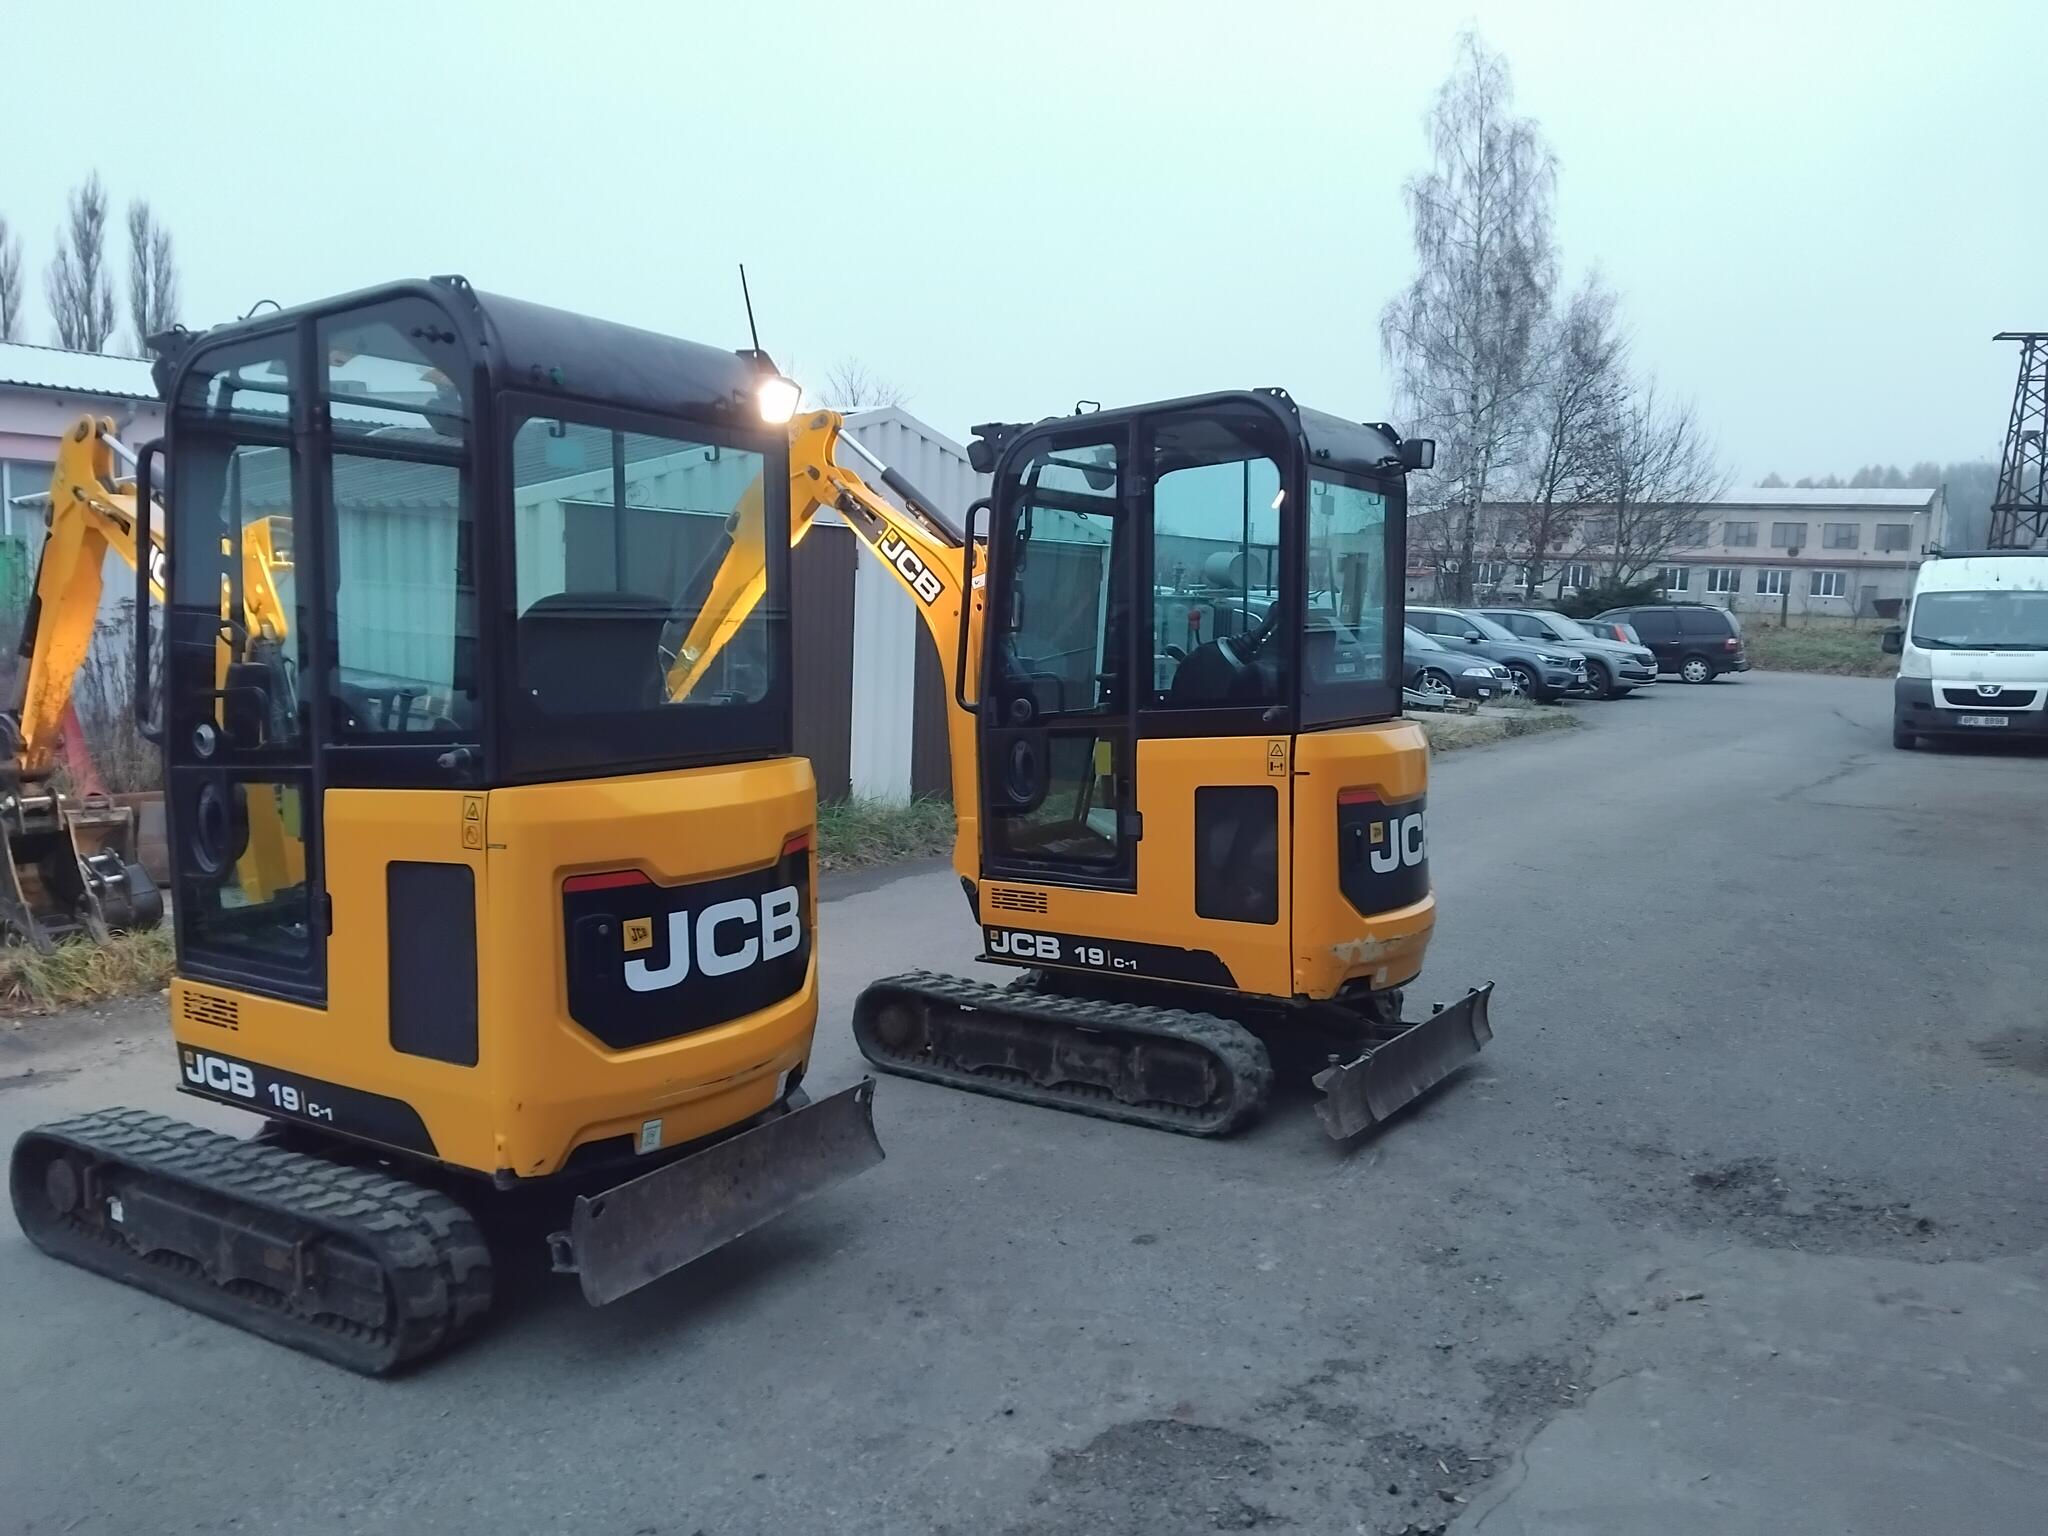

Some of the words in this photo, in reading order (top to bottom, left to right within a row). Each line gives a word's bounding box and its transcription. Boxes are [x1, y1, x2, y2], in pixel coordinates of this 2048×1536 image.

[880, 540, 941, 602] JCB
[624, 886, 800, 992] JCB
[631, 927, 648, 942] JCB
[990, 931, 1061, 960] JCB
[1074, 946, 1105, 965] 19
[185, 1054, 256, 1098] JCB
[267, 1083, 300, 1111] 19
